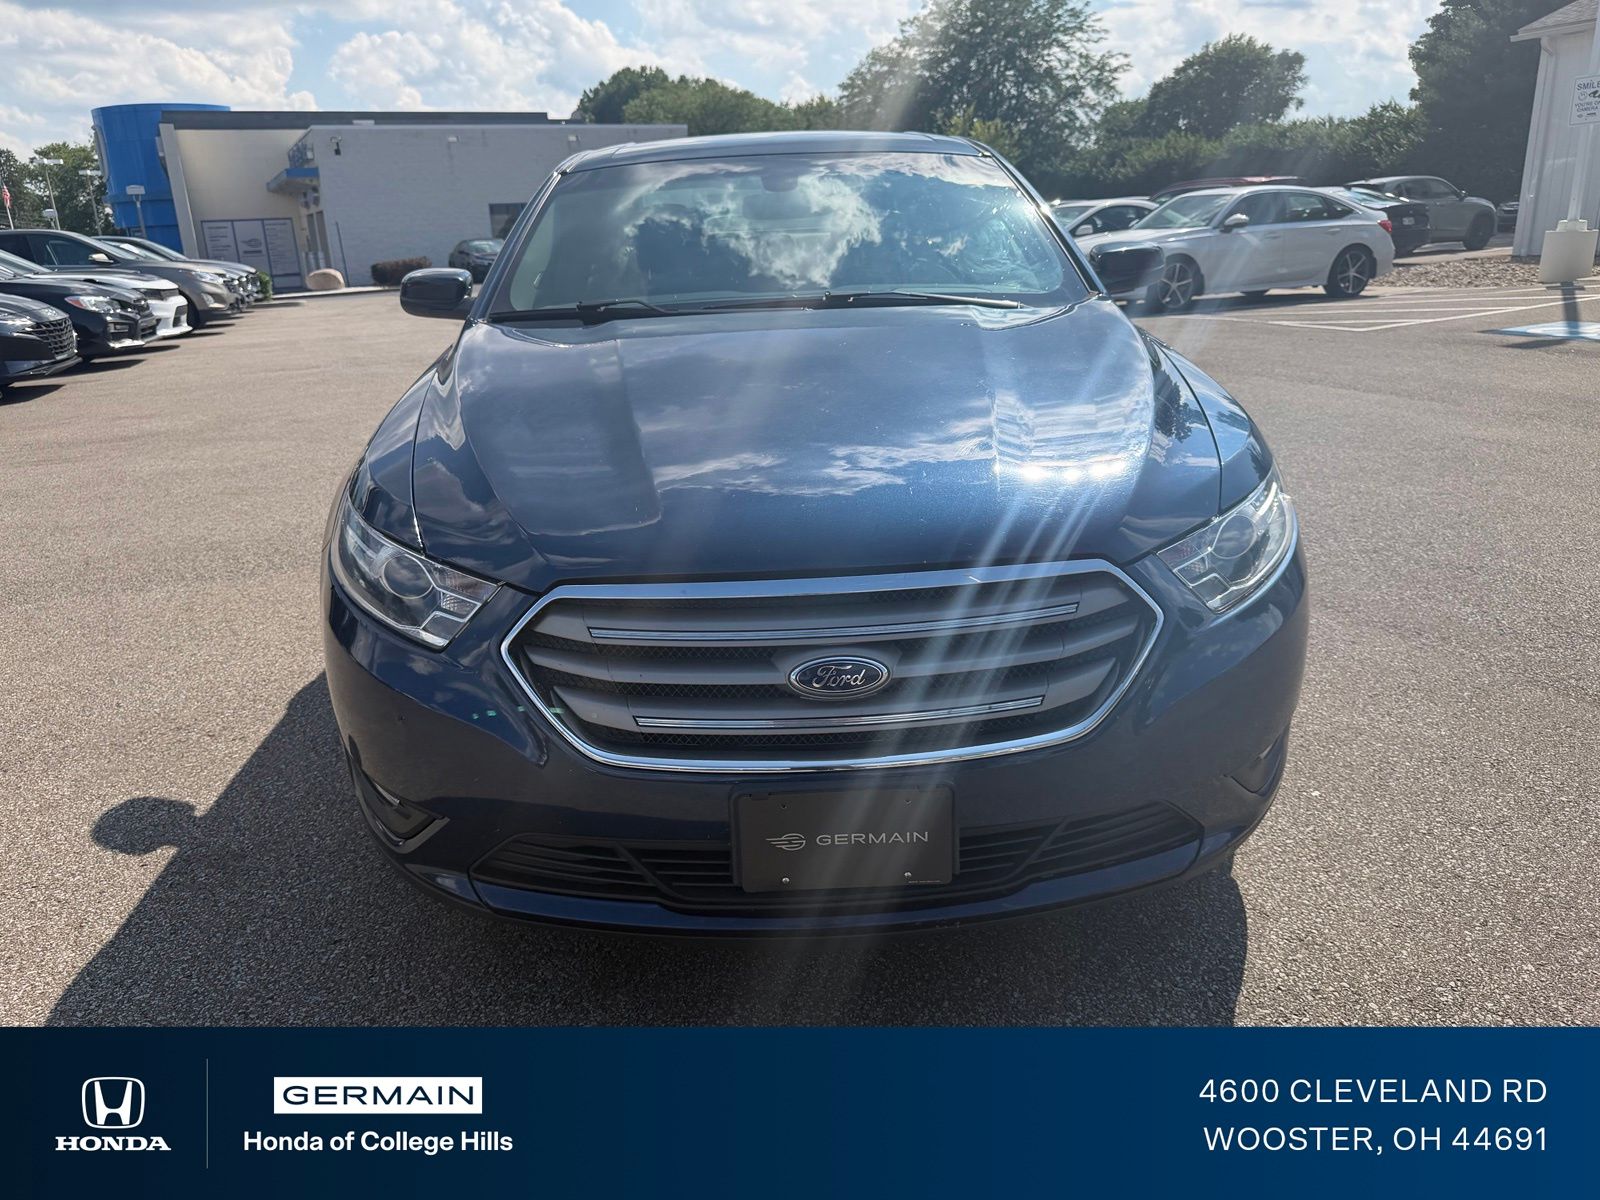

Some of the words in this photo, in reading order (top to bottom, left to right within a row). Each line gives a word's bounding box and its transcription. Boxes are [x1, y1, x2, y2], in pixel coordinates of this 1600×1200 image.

[1576, 80, 1600, 90] SMILE
[812, 665, 866, 688] Ford
[816, 831, 929, 845] GERMAIN
